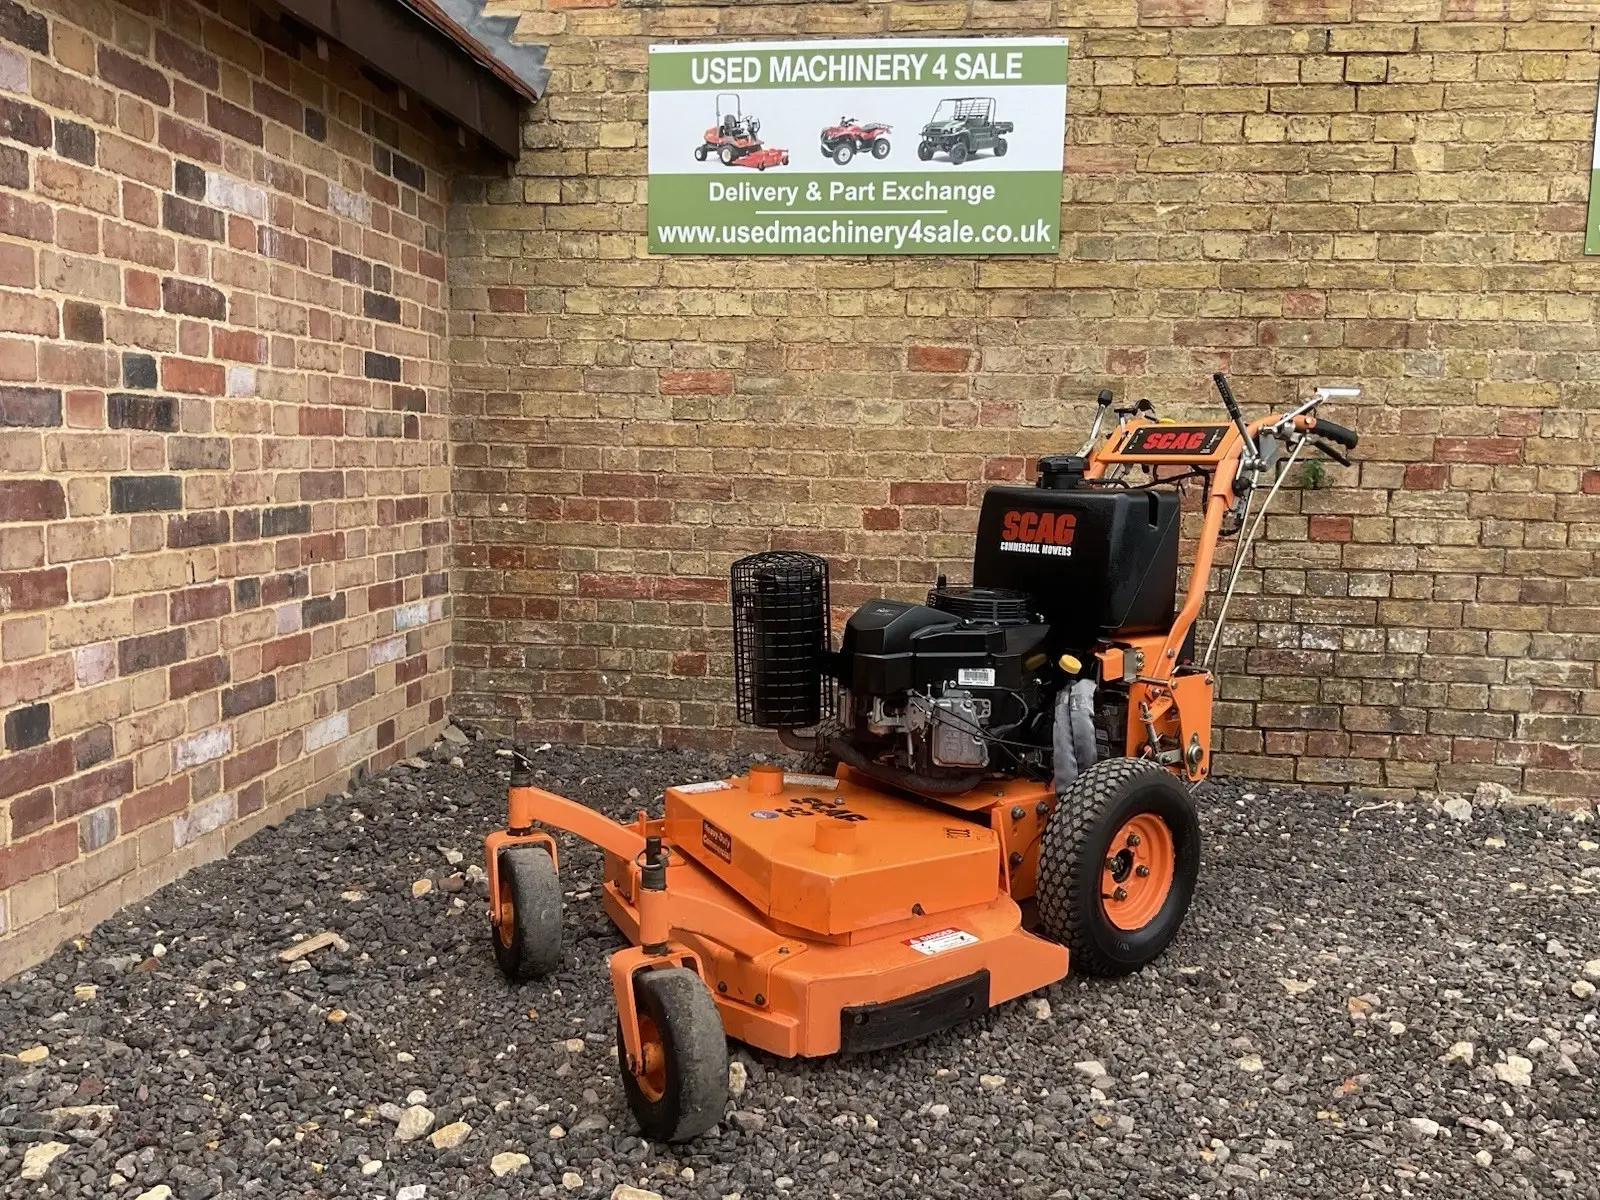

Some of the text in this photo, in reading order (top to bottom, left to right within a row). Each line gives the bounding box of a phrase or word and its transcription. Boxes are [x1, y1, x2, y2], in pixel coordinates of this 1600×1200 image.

[691, 52, 1023, 84] USED MACHINERY 4 SALE
[709, 180, 996, 206] Delivery & Part Exchange
[657, 218, 1051, 249] www.usedmachinery4sale.co.uk
[1143, 432, 1206, 450] SCAG
[1002, 510, 1077, 546] SCAG
[1000, 541, 1040, 554] COMMERCIAL
